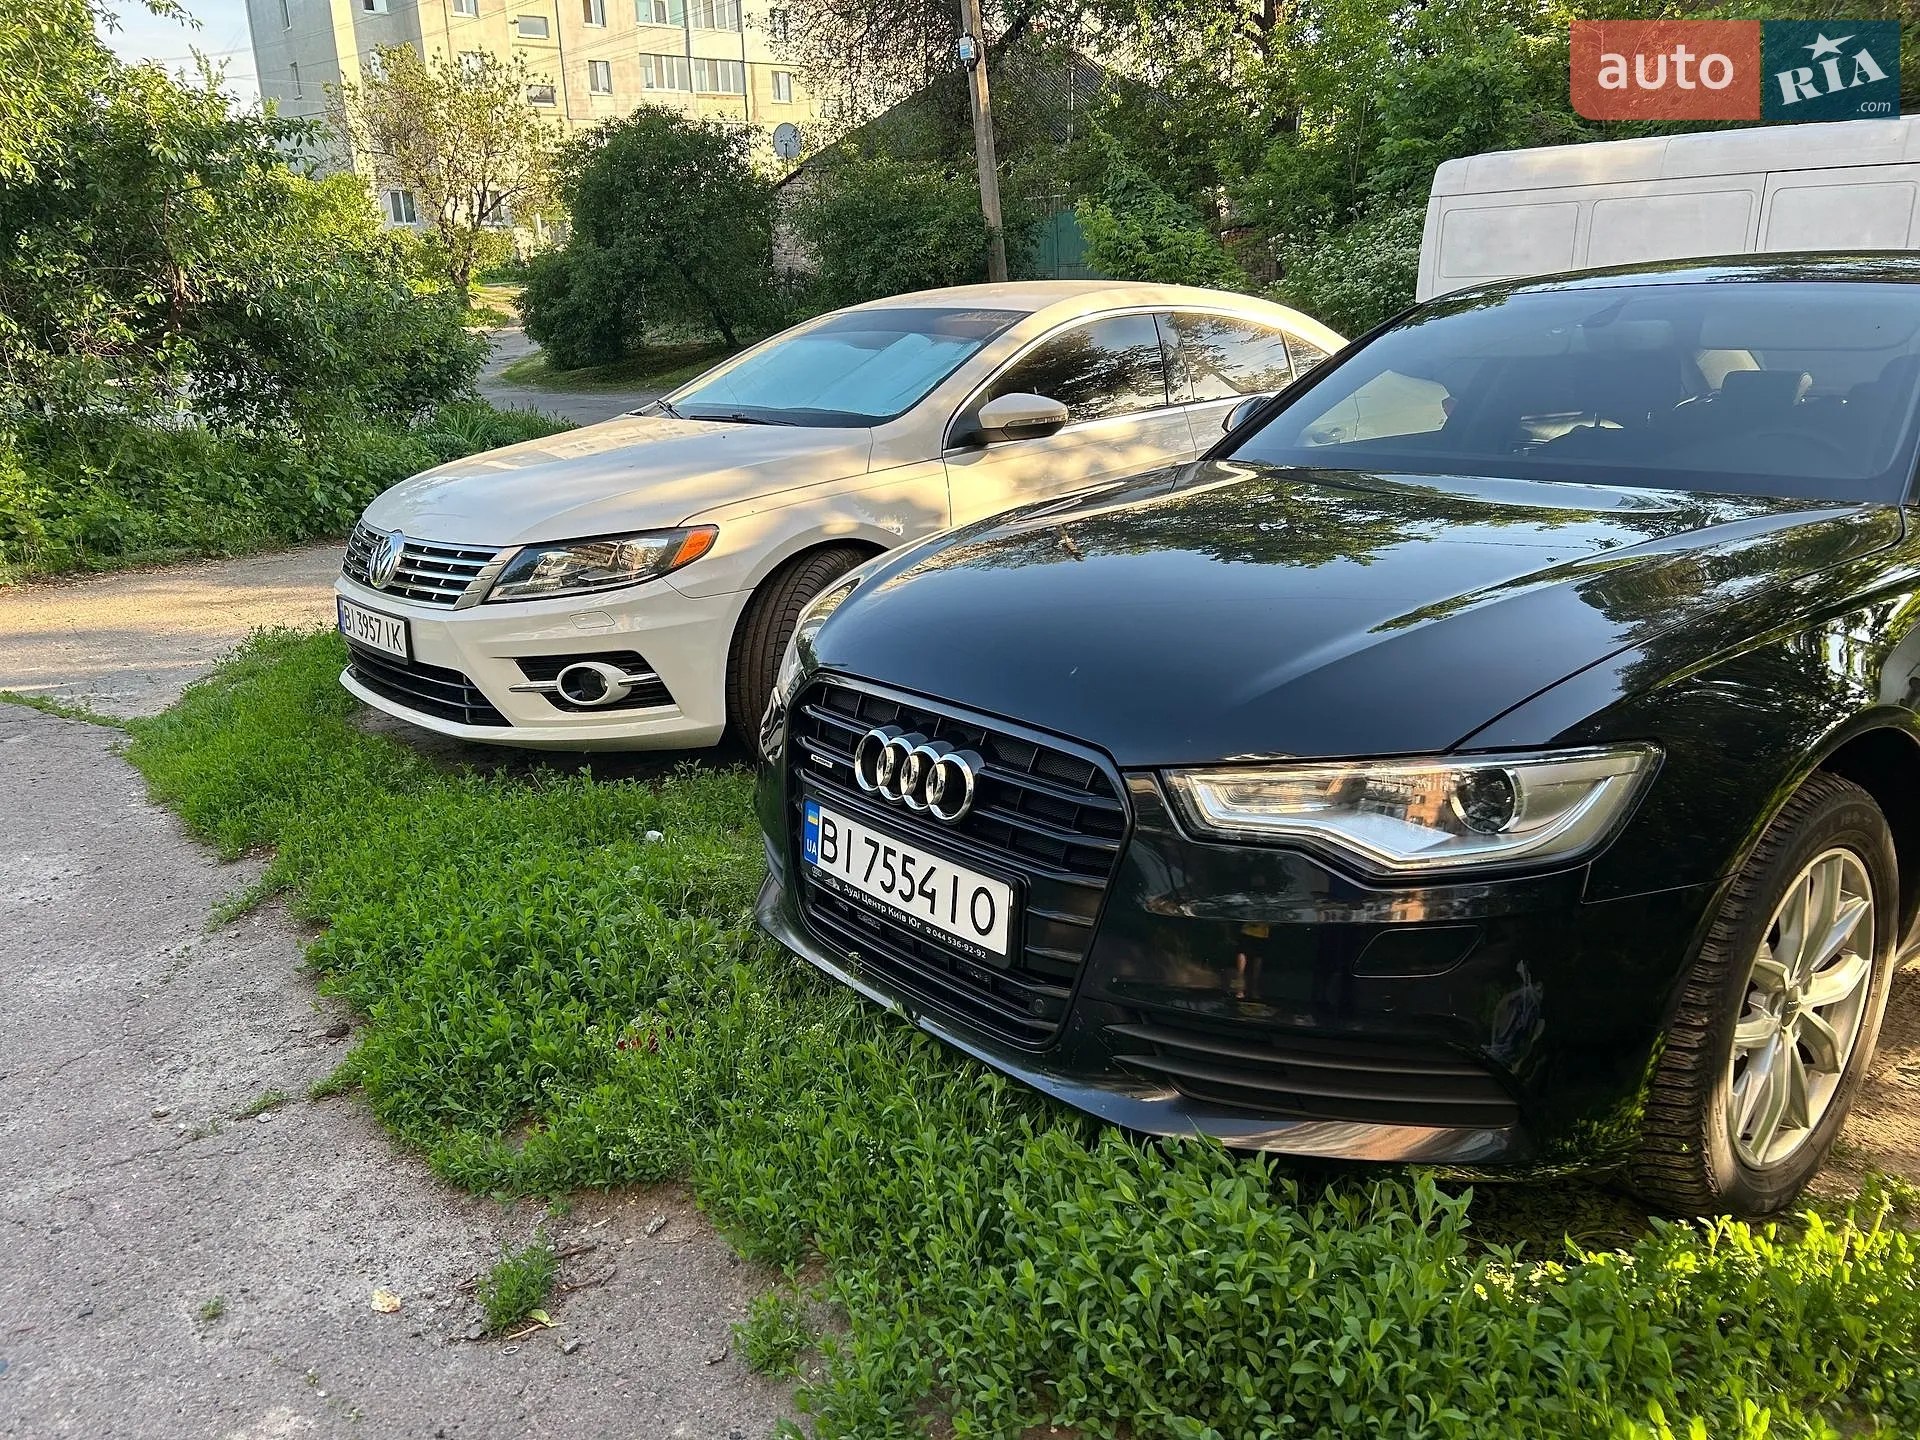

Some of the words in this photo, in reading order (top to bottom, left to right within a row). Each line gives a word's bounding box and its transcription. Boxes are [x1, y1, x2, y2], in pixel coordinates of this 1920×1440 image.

[356, 611, 381, 644] 3957
[385, 621, 403, 652] IK
[806, 839, 817, 855] UA
[863, 837, 937, 915] 7554
[861, 893, 887, 913] Центр
[888, 906, 907, 923] Київ
[908, 915, 921, 929] Юг
